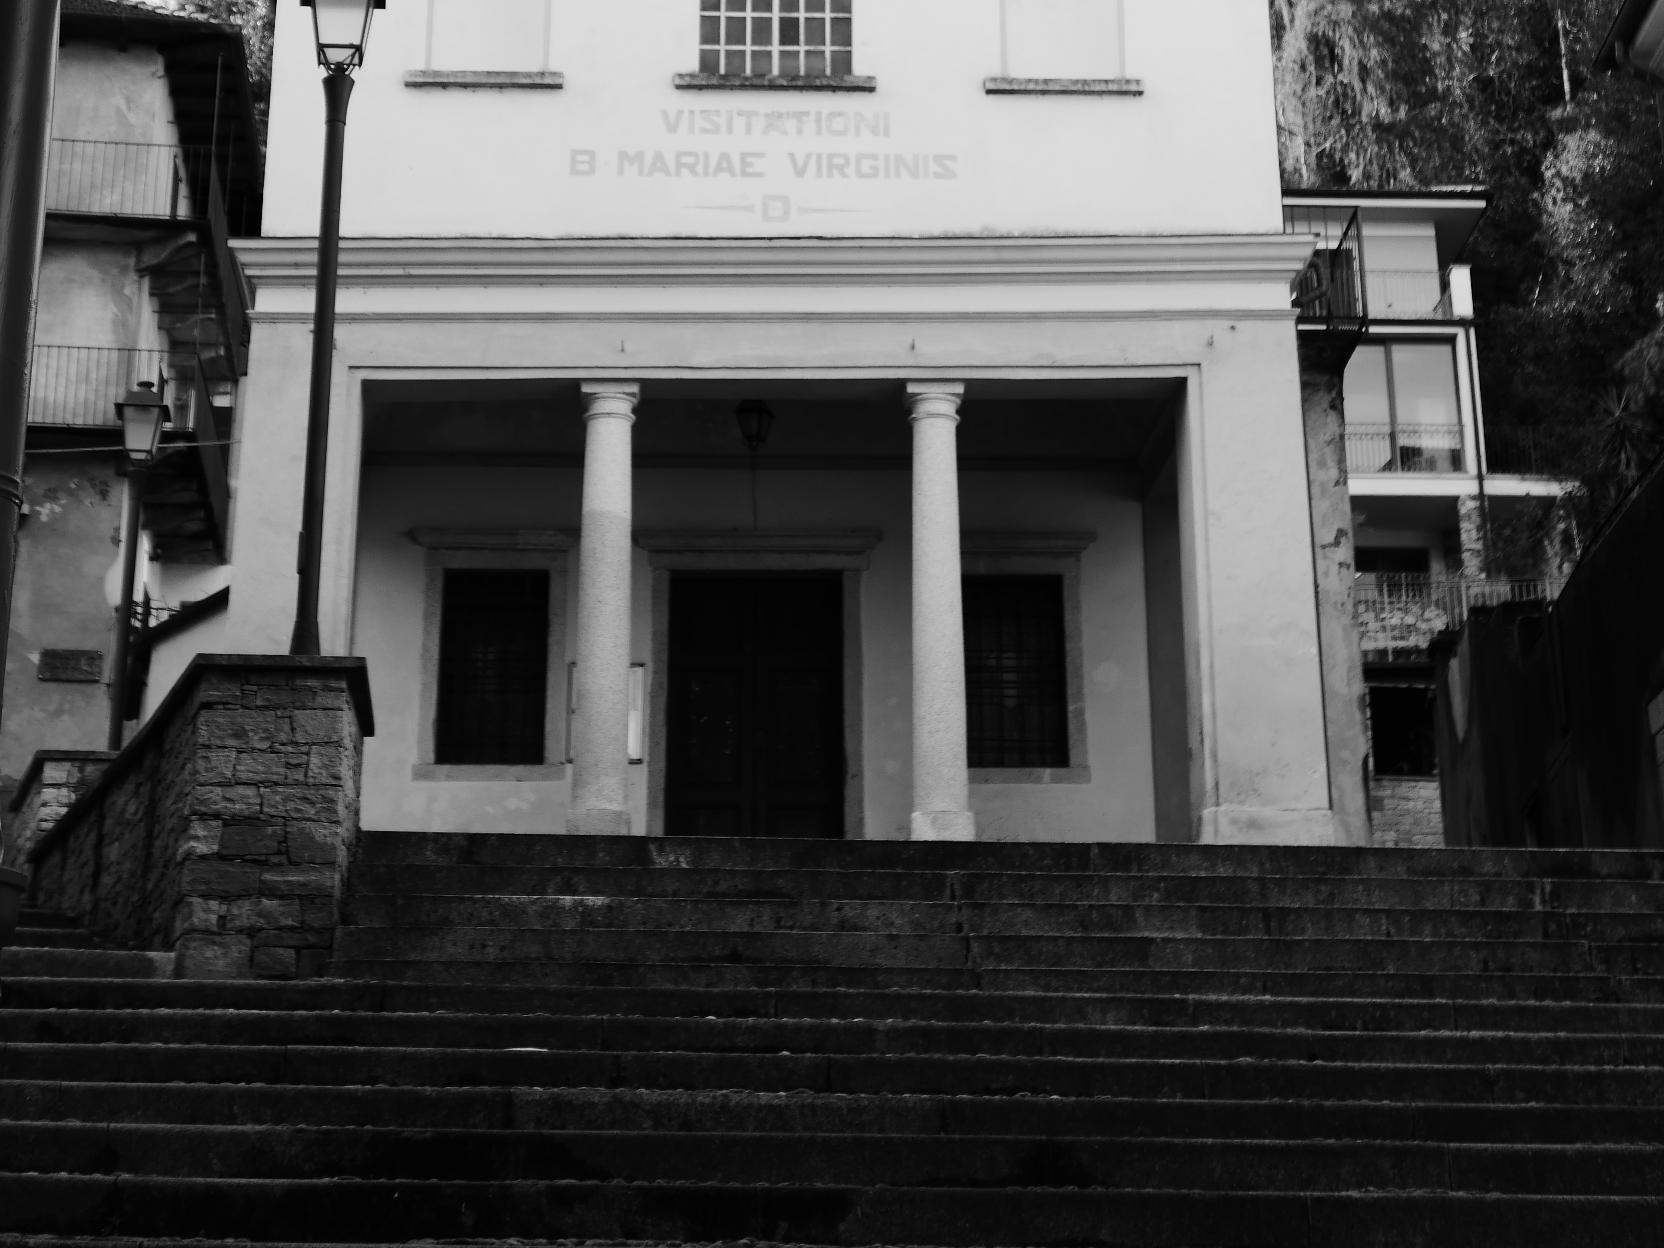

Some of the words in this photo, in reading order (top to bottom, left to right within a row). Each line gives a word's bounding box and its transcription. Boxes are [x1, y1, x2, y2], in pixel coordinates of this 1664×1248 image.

[660, 109, 891, 138] VISITATIONI
[617, 150, 766, 179] MARIAE
[789, 153, 959, 180] VIRGINIS
